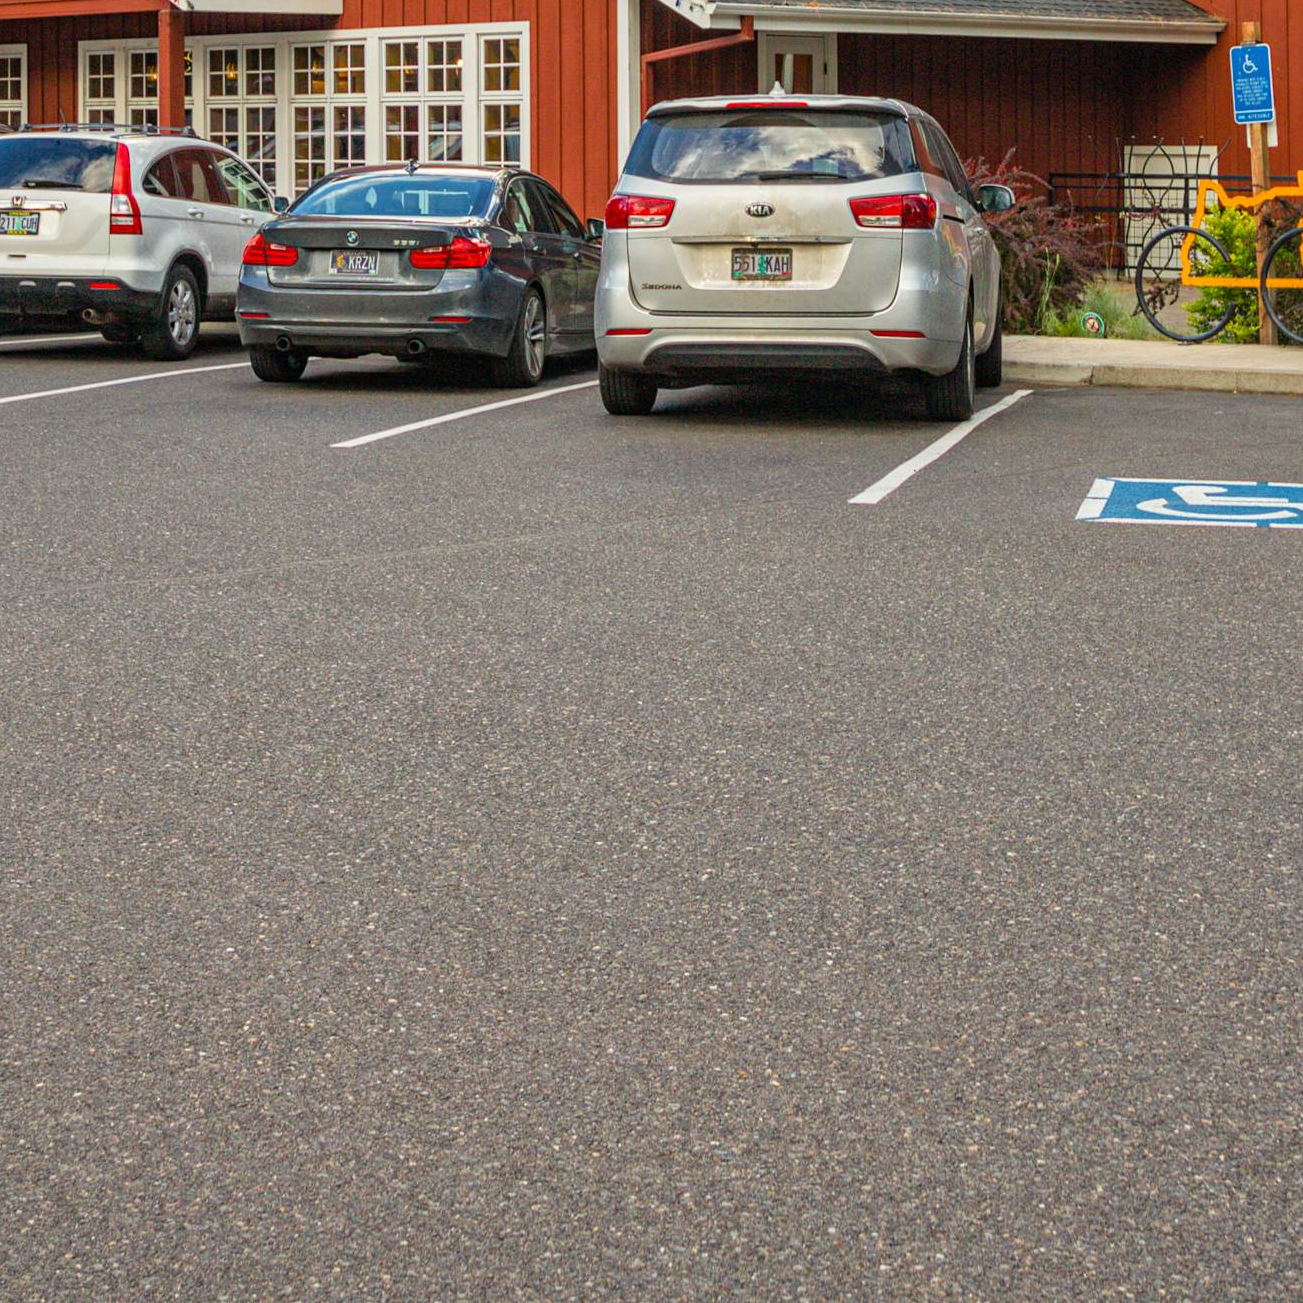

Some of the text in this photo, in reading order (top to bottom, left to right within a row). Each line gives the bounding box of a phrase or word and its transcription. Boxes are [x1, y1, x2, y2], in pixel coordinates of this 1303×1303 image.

[750, 205, 770, 215] KIA
[0, 217, 15, 230] 211
[348, 255, 375, 270] KRZN
[766, 255, 789, 272] KAH
